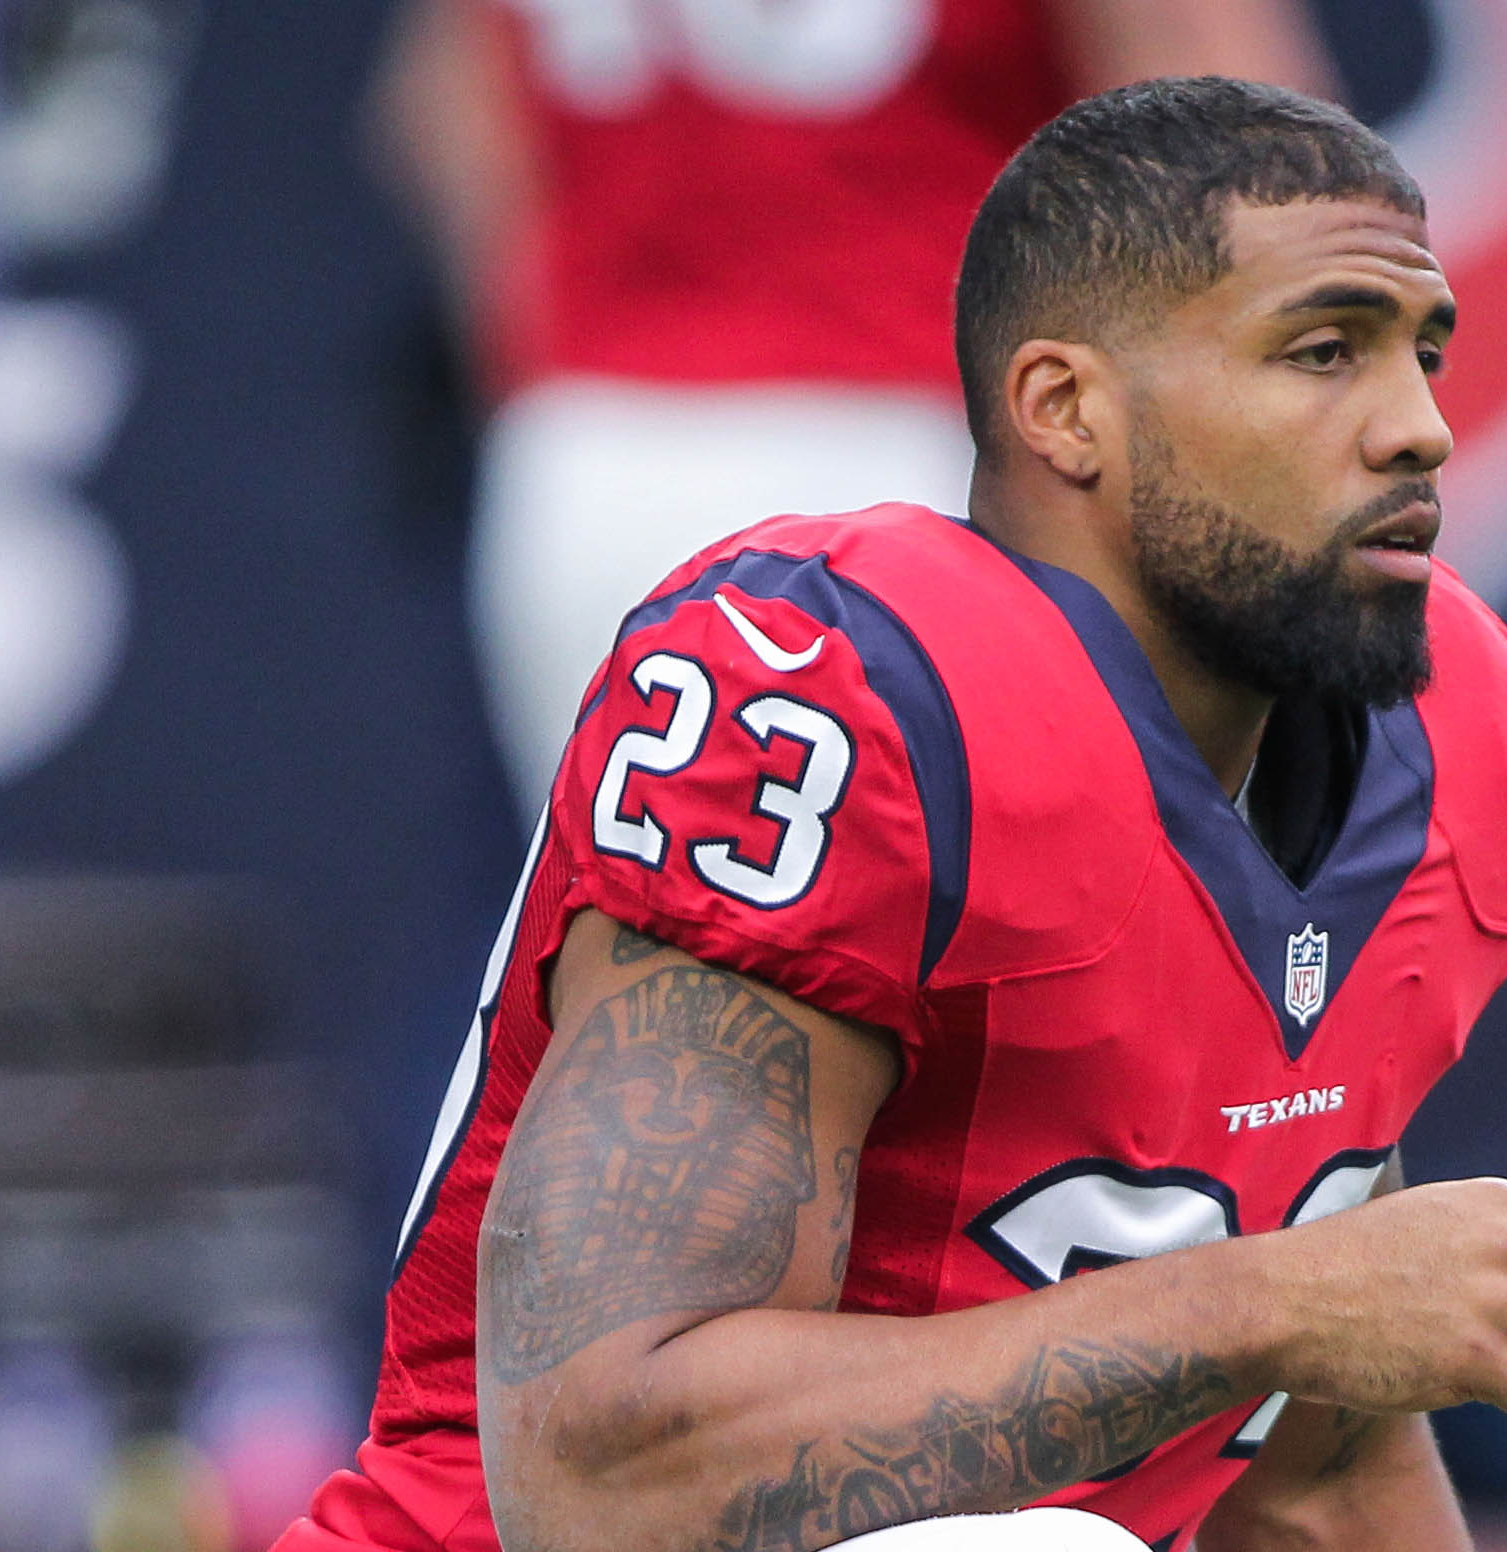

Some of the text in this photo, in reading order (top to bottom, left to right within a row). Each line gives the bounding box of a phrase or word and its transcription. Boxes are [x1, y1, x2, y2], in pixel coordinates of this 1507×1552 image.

[592, 650, 858, 912] 23
[1291, 968, 1319, 1006] NFL
[1220, 1085, 1347, 1133] TEXANS
